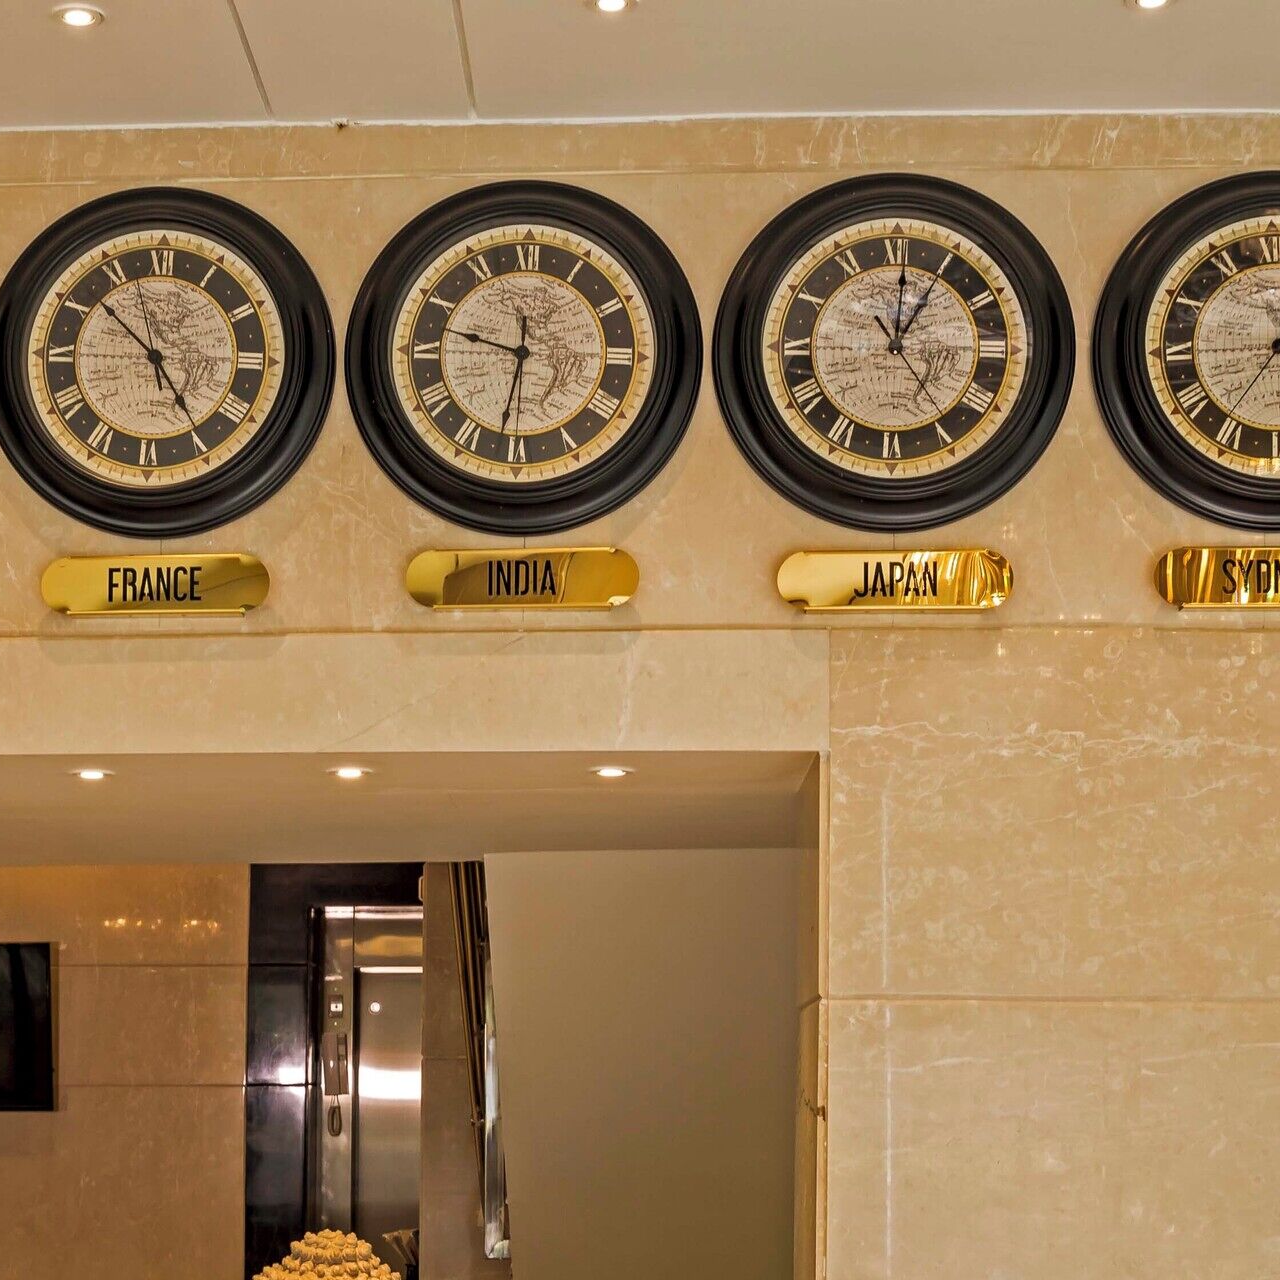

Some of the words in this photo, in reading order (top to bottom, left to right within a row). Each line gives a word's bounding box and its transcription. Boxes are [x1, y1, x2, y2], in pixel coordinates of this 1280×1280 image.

[150, 250, 174, 275] XII
[515, 246, 539, 270] XII
[884, 239, 908, 264] XII
[567, 260, 584, 283] I
[937, 253, 953, 276] I
[200, 265, 217, 288] I
[65, 296, 90, 318] X
[429, 291, 454, 314] X
[596, 298, 623, 317] II
[798, 287, 824, 310] X
[968, 290, 994, 310] II
[1176, 292, 1203, 313] X
[228, 303, 254, 322] II
[239, 353, 263, 369] III
[606, 348, 632, 365] III
[979, 341, 1005, 358] III
[108, 566, 202, 602] FRANCE
[488, 560, 556, 596] INDIA
[854, 561, 937, 597] JAPAN
